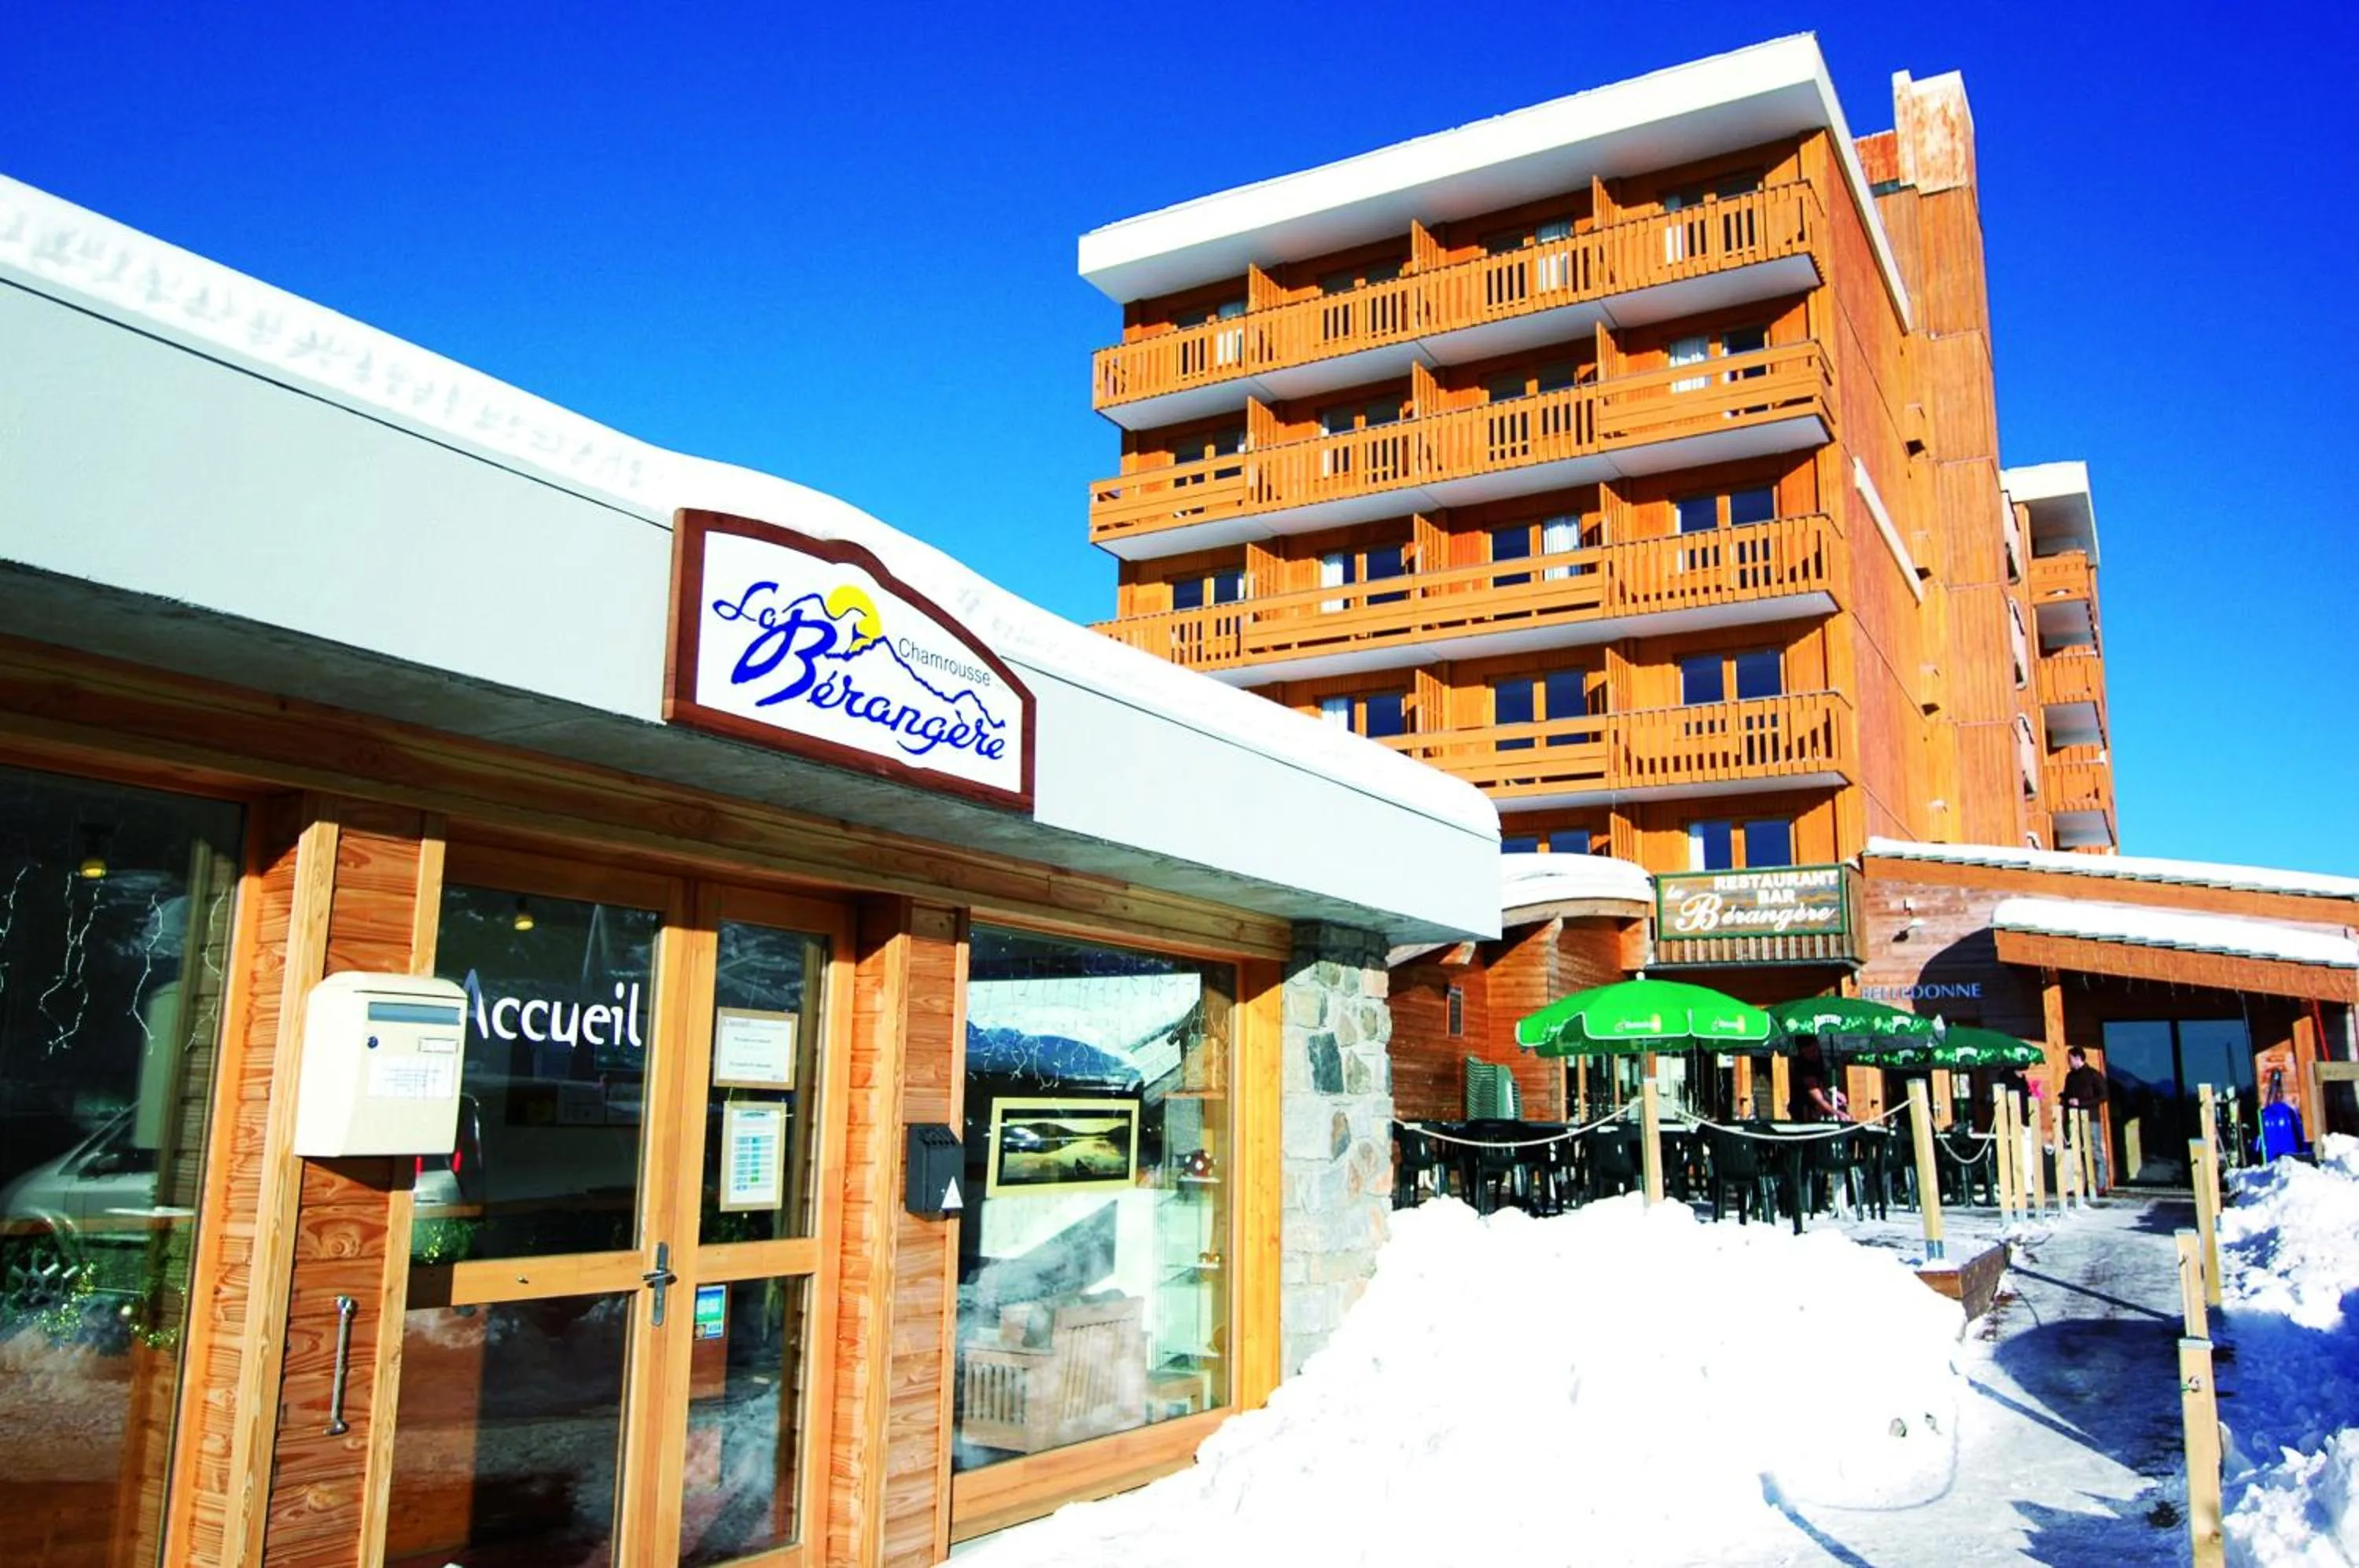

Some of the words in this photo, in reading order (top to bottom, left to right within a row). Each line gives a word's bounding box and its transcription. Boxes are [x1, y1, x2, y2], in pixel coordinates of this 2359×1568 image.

[712, 580, 778, 628] La
[899, 638, 991, 686] Chamrousse
[731, 609, 1004, 760] Bérangère
[1714, 870, 1838, 890] RESTAURANT
[1757, 889, 1795, 905] BAR
[1675, 893, 1836, 931] Bérangère
[461, 969, 642, 1047] Accueil
[1861, 982, 1982, 1000] BELLEDONNE
